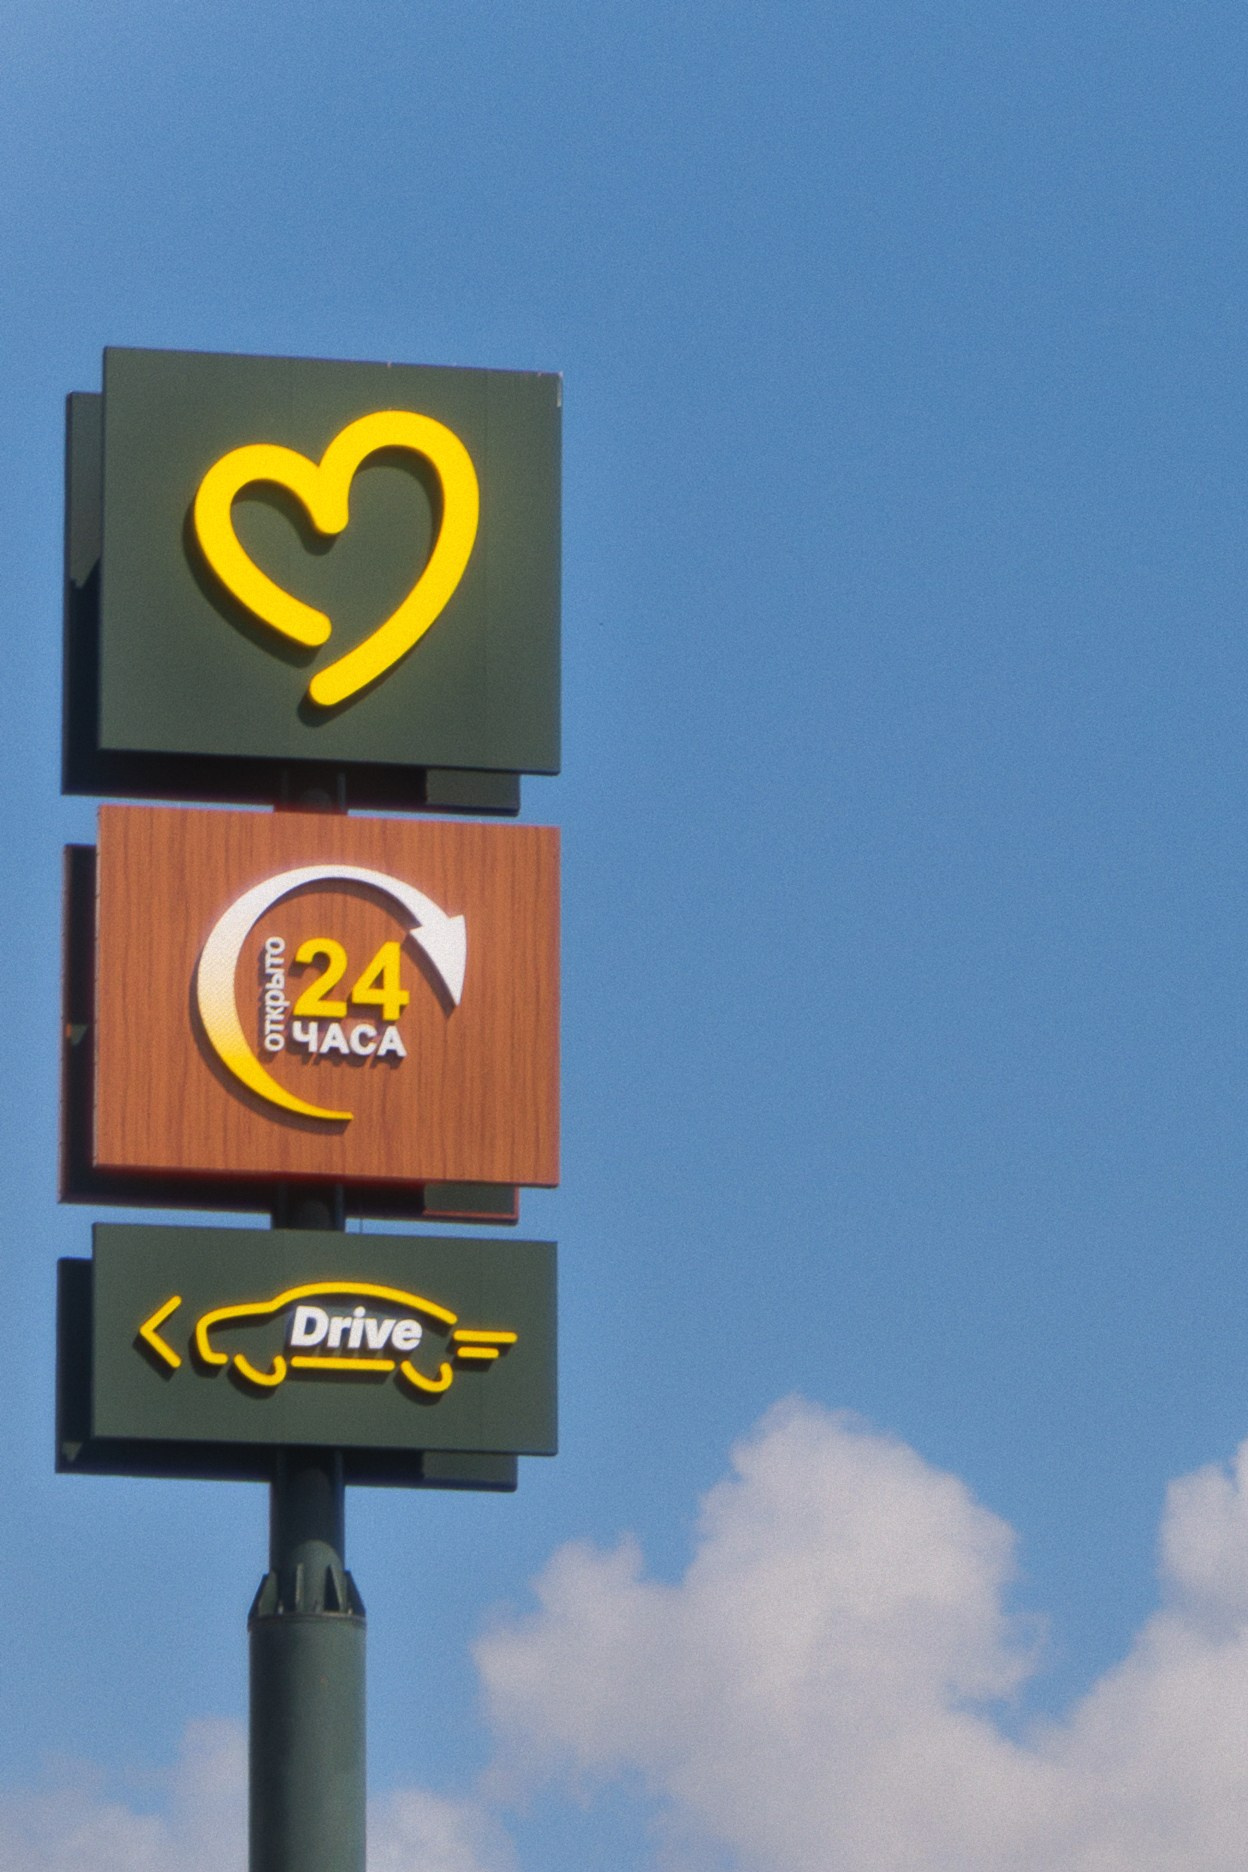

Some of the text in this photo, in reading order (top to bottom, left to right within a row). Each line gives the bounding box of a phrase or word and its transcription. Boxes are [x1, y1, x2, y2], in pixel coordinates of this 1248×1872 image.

[294, 938, 410, 1020] 24
[293, 1021, 407, 1057] ЧАСА
[291, 1305, 422, 1351] Drive
